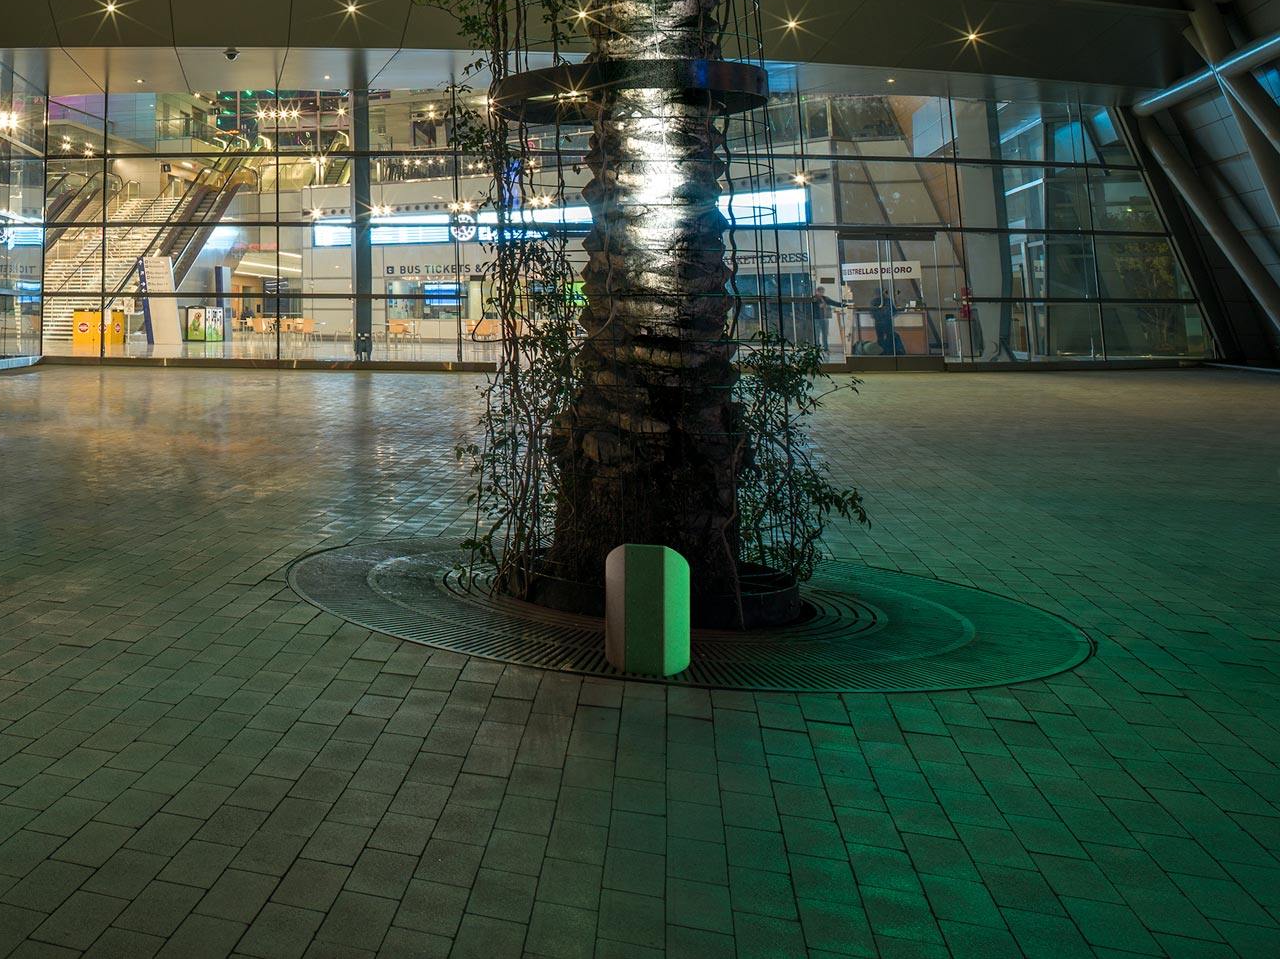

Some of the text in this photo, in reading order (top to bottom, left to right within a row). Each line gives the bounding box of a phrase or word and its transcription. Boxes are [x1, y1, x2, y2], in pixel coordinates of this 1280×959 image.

[400, 265, 421, 274] BUS
[425, 264, 470, 274] TICKETS
[847, 267, 879, 276] ESTRELLAS
[894, 266, 912, 274] ORO
